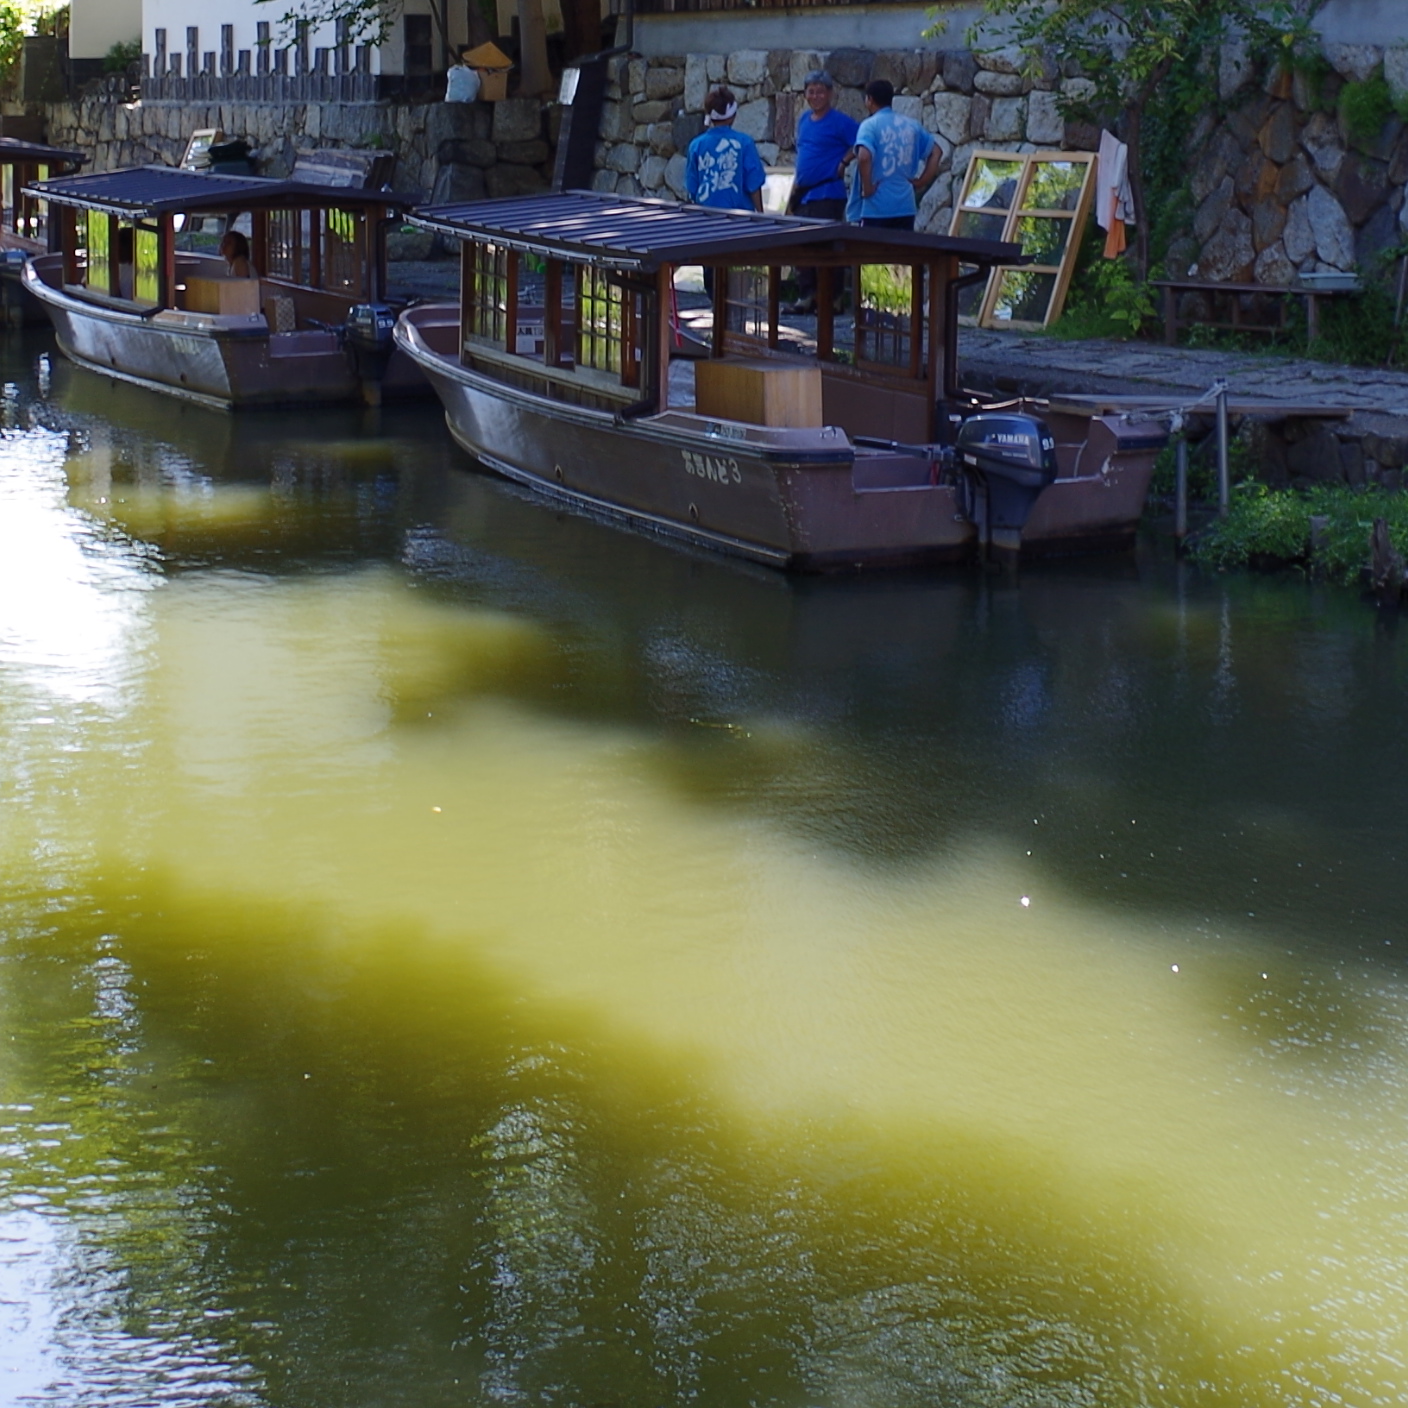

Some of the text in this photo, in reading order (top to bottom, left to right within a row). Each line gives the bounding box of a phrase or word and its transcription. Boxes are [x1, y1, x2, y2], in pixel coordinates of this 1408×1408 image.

[697, 150, 715, 203] めぐり
[710, 137, 741, 194] 八幡堀
[996, 433, 1030, 446] YAMAHA
